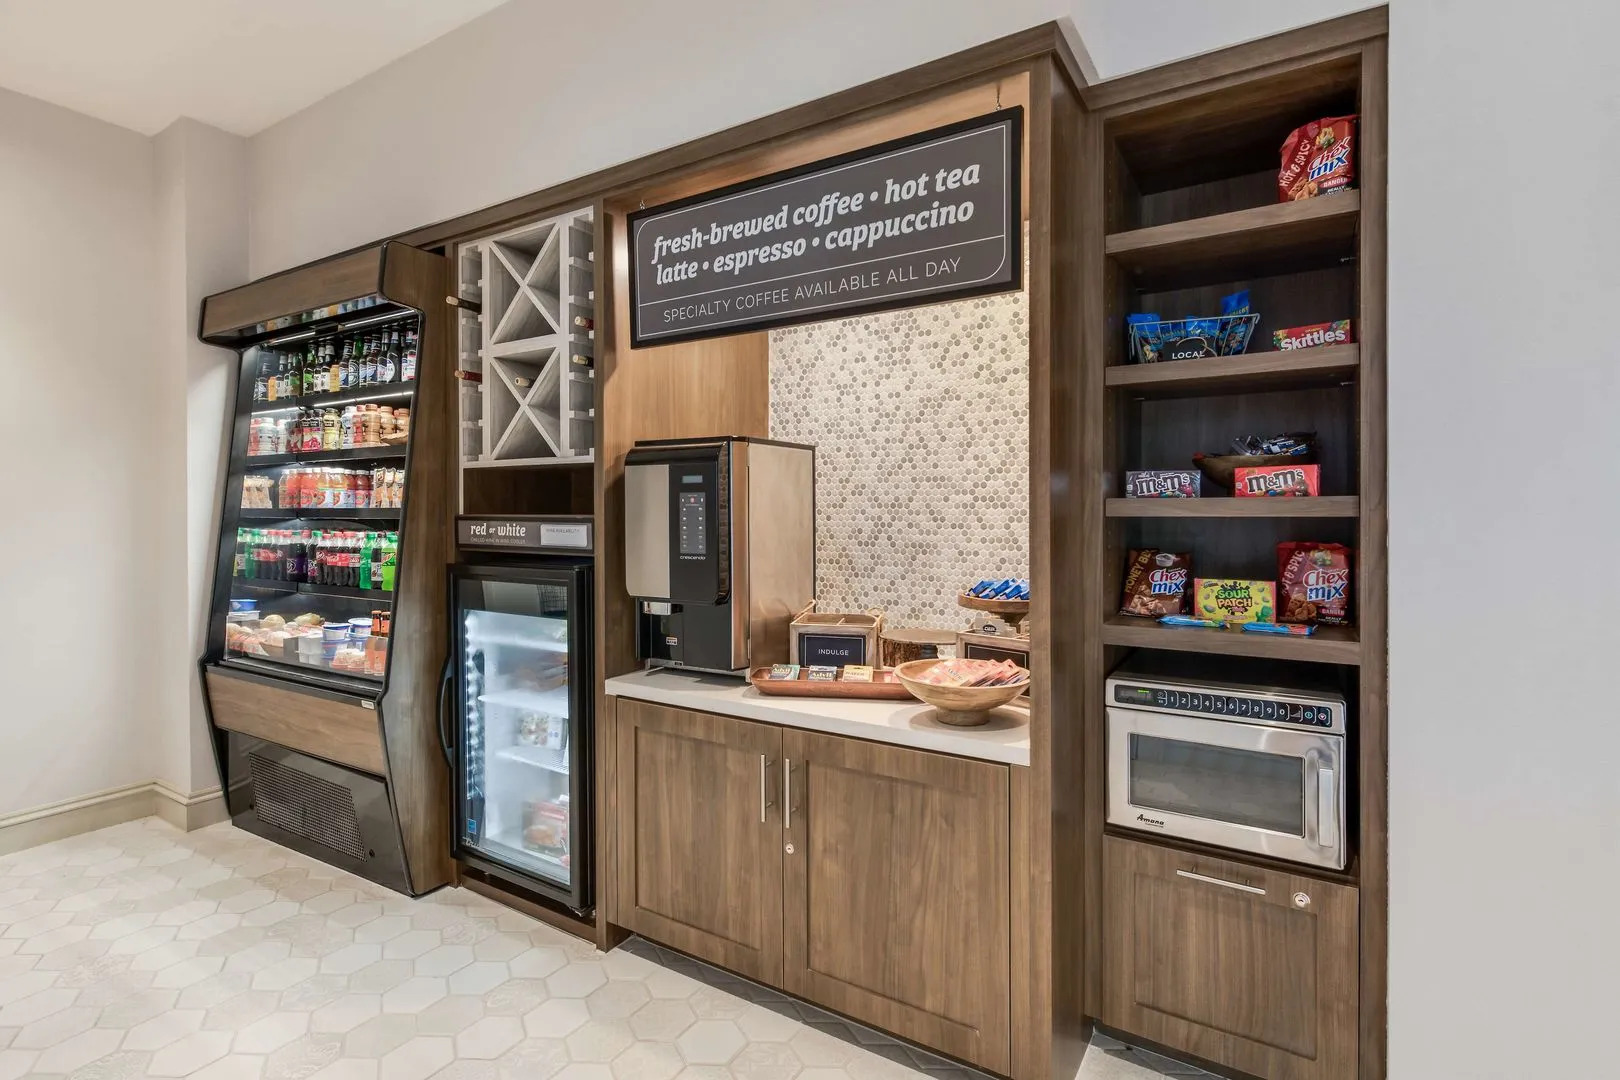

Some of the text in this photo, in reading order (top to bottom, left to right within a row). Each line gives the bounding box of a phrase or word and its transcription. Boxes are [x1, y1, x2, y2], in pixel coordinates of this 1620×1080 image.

[1279, 170, 1297, 187] HOT
[1294, 139, 1310, 166] SPICY
[1309, 147, 1351, 181] mix
[651, 164, 980, 264] fresh-brewed coffee hot tea
[656, 200, 975, 285] latte espresso cappuccino
[663, 256, 961, 323] SPECIALTY COFFEE AVAILABLE ALL DAY
[1280, 329, 1346, 352] Skittles
[1172, 350, 1205, 360] LOCAL
[470, 522, 487, 536] red
[497, 523, 526, 537] white
[1149, 568, 1187, 584] Chex
[1303, 569, 1349, 588] Chex
[1151, 580, 1186, 595] mix
[1217, 589, 1249, 599] SOUR
[1307, 582, 1347, 602] mix
[1217, 598, 1252, 608] PATCH
[818, 648, 849, 656] INDULGE
[1136, 813, 1165, 826] Amana
